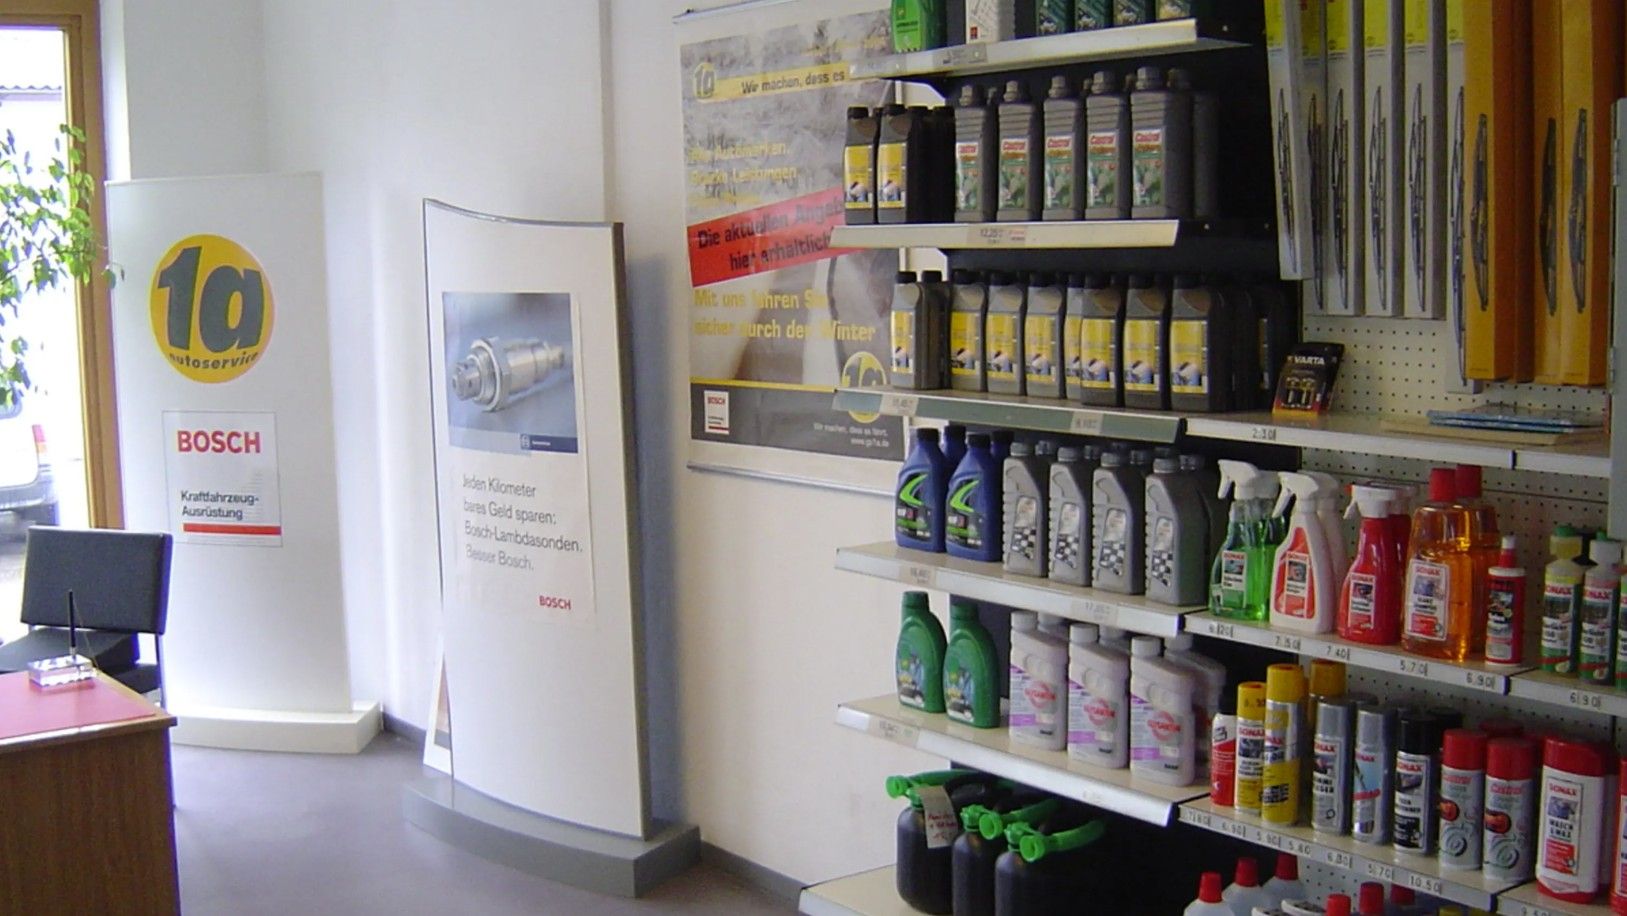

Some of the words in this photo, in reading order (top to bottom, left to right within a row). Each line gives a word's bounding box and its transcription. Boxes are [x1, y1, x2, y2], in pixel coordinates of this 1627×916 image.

[742, 80, 758, 94] Wir
[805, 74, 829, 86] dass
[833, 70, 846, 82] es
[697, 229, 720, 249] Die
[724, 212, 789, 242] aktuellen
[729, 249, 756, 271] hier
[157, 245, 265, 353] 1a
[693, 289, 716, 307] Mit
[722, 291, 744, 307] uns
[820, 321, 877, 342] Winter
[169, 352, 258, 369] autoservice
[1294, 356, 1325, 366] VARTA
[177, 430, 261, 453] BOSCH
[463, 473, 487, 491] Jeden
[488, 477, 537, 497] Kilometer
[181, 490, 260, 506] Kraftfahrzeug-
[463, 498, 487, 516] bares
[488, 501, 513, 519] Geld
[182, 506, 244, 521] Ausrüstung
[464, 520, 584, 553] Bosch-Lambdasonden.
[498, 550, 535, 572] Bosch.
[1415, 566, 1441, 577] SONAX
[538, 595, 572, 611] BOSCH
[1549, 783, 1577, 797] SONAX
